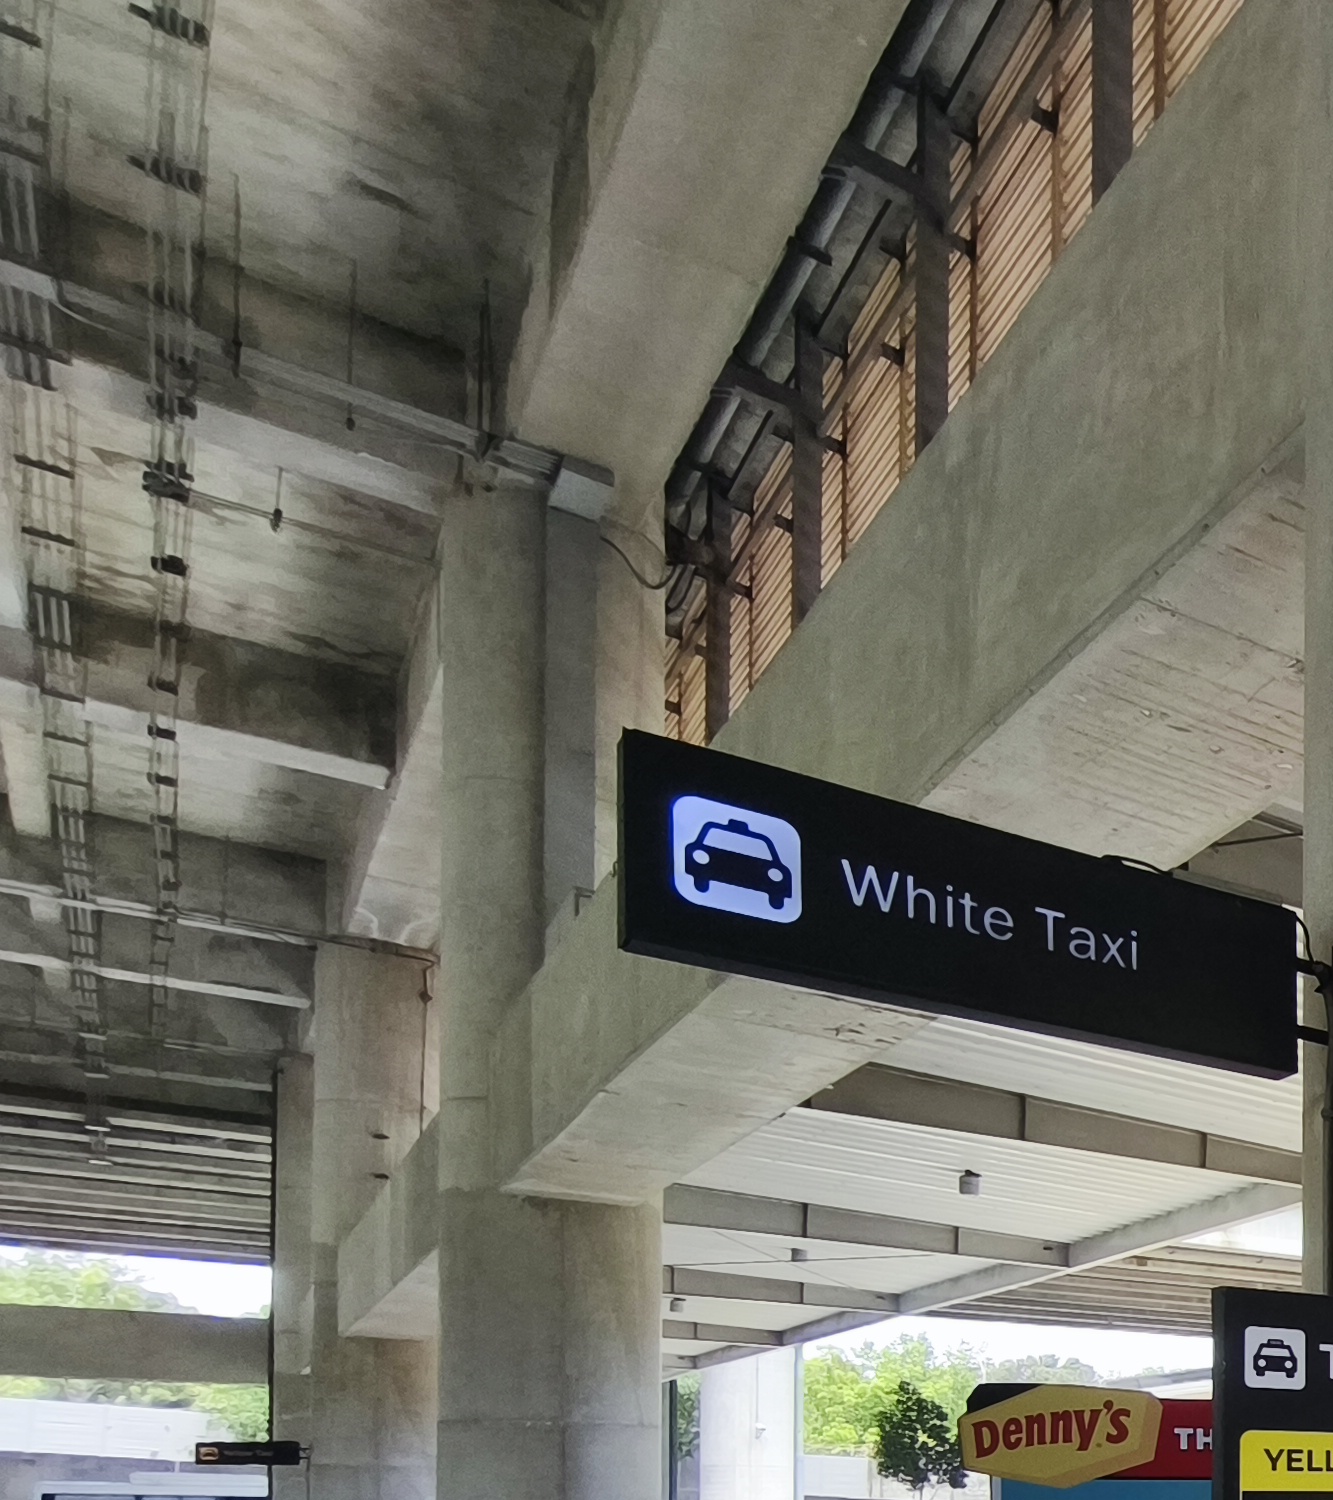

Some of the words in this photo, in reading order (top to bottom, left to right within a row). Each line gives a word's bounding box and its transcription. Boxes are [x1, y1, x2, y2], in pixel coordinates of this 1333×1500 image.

[841, 858, 1015, 942] White
[1034, 905, 1139, 971] Taxi
[970, 1399, 1131, 1459] Denny's
